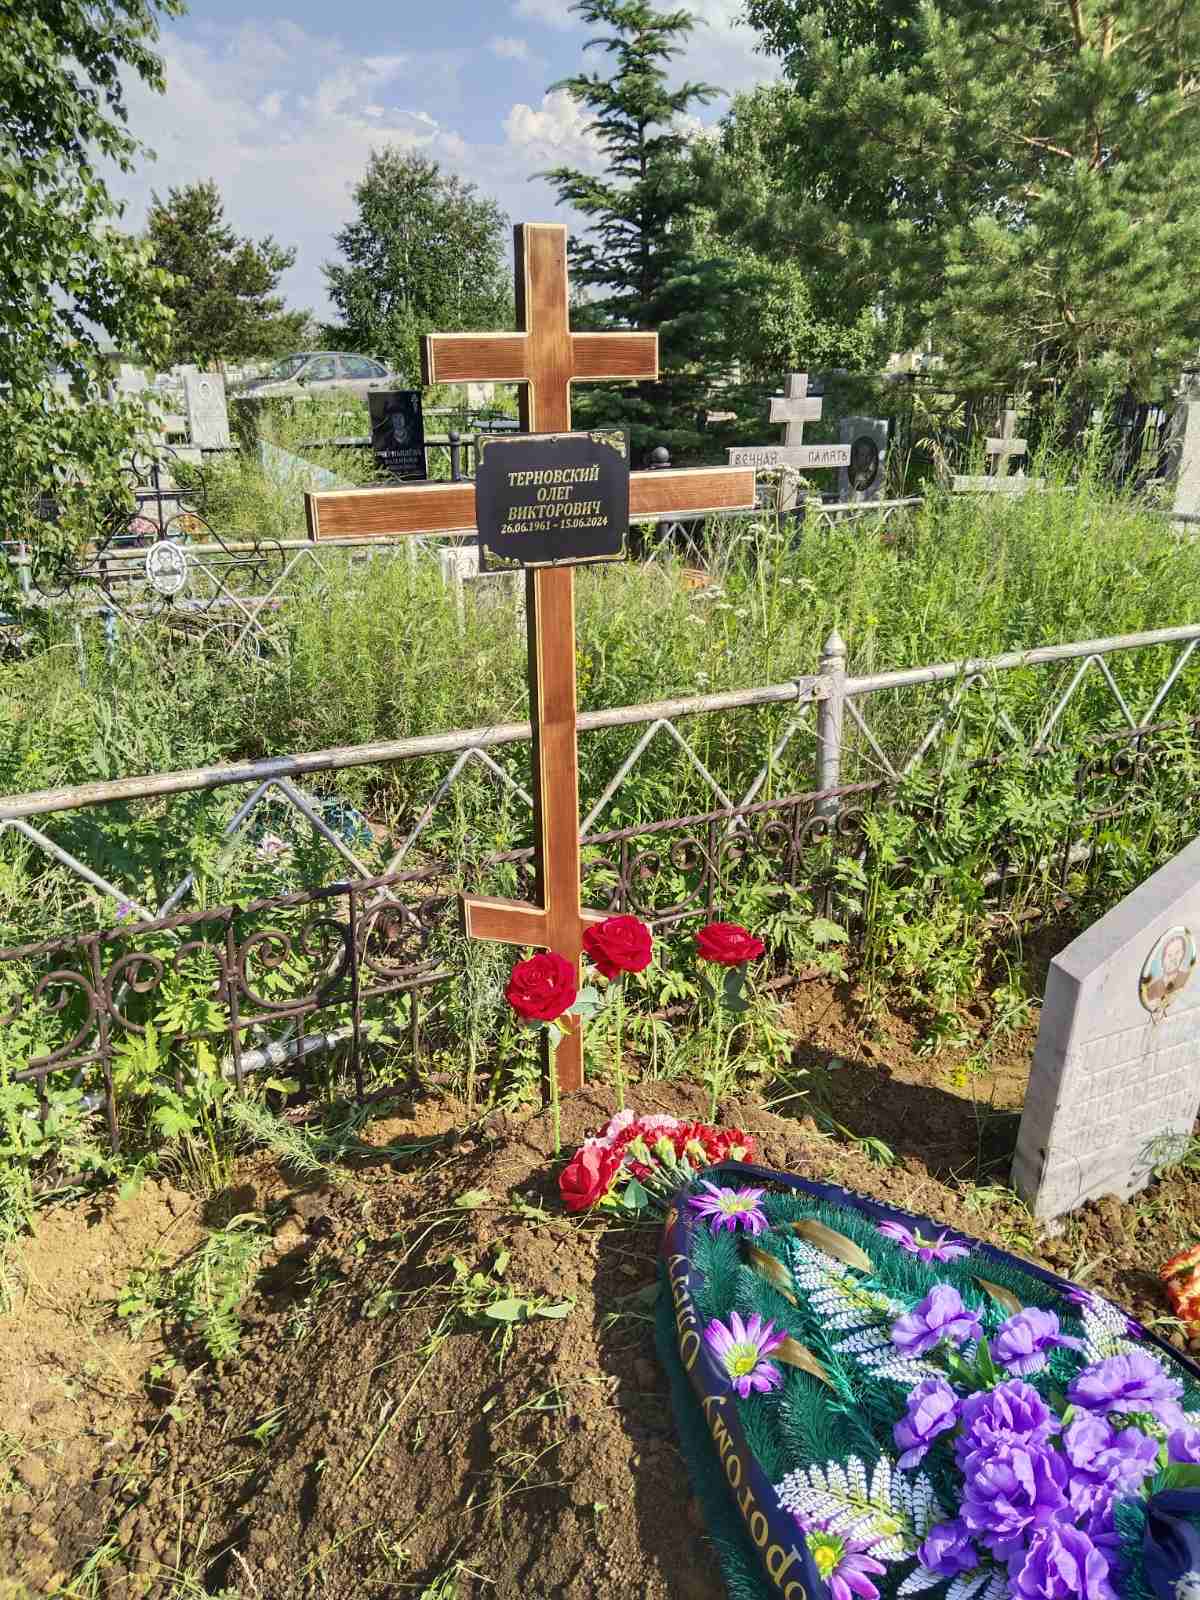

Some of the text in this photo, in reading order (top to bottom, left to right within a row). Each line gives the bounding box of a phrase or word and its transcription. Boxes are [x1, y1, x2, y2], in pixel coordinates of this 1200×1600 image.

[808, 449, 848, 464] ПАМЯТЬ
[508, 464, 600, 487] ТЕРНОВСКИЙ
[537, 486, 573, 501] ОЛЕГ
[508, 501, 601, 521] ВИКТОРОВИЧ
[501, 520, 551, 534] 26.06.1961
[560, 516, 608, 529] 15.06.2024
